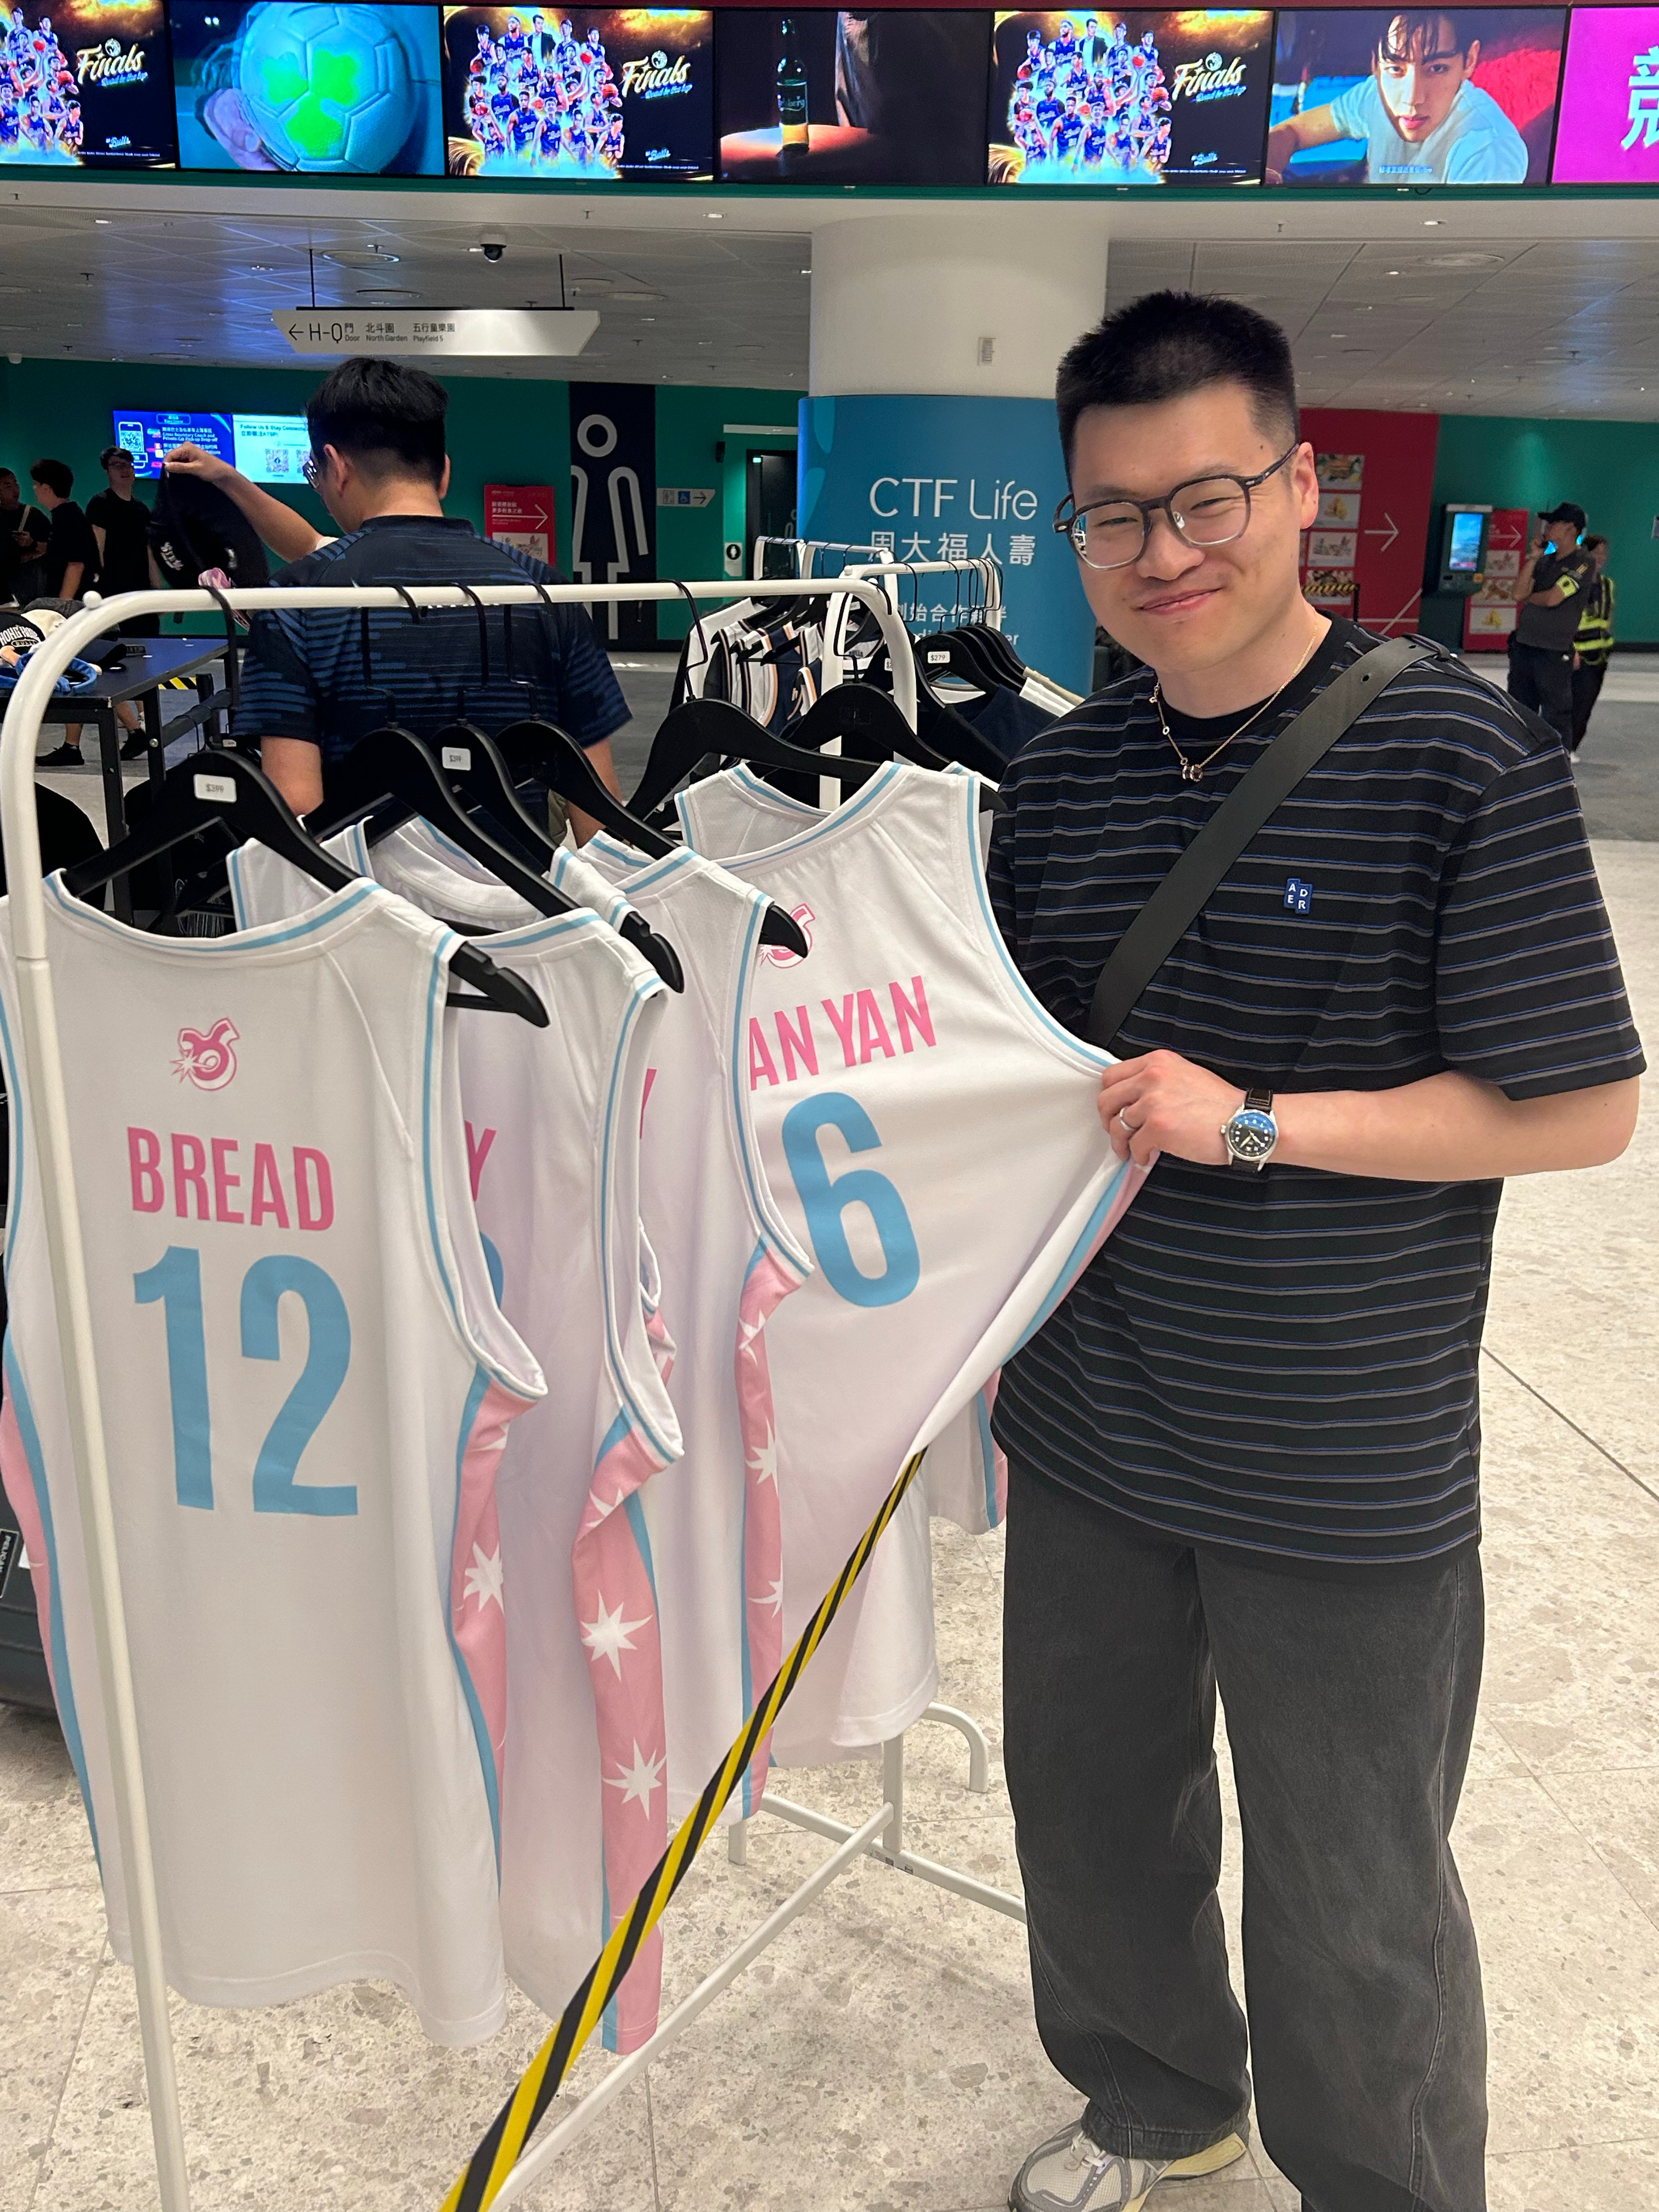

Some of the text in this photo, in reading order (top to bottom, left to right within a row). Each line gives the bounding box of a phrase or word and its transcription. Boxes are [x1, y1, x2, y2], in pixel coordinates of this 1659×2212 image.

[77, 42, 145, 84] Finals
[622, 53, 691, 97] Finals
[1172, 55, 1246, 100] Finals
[309, 323, 354, 344] H-Q 門
[413, 335, 438, 343] Playfield
[870, 477, 1038, 521] CTF Life
[868, 530, 1036, 566] 周大福人壽
[127, 1126, 335, 1231] BREAD
[781, 1091, 921, 1307] 6
[133, 1245, 358, 1517] 12
